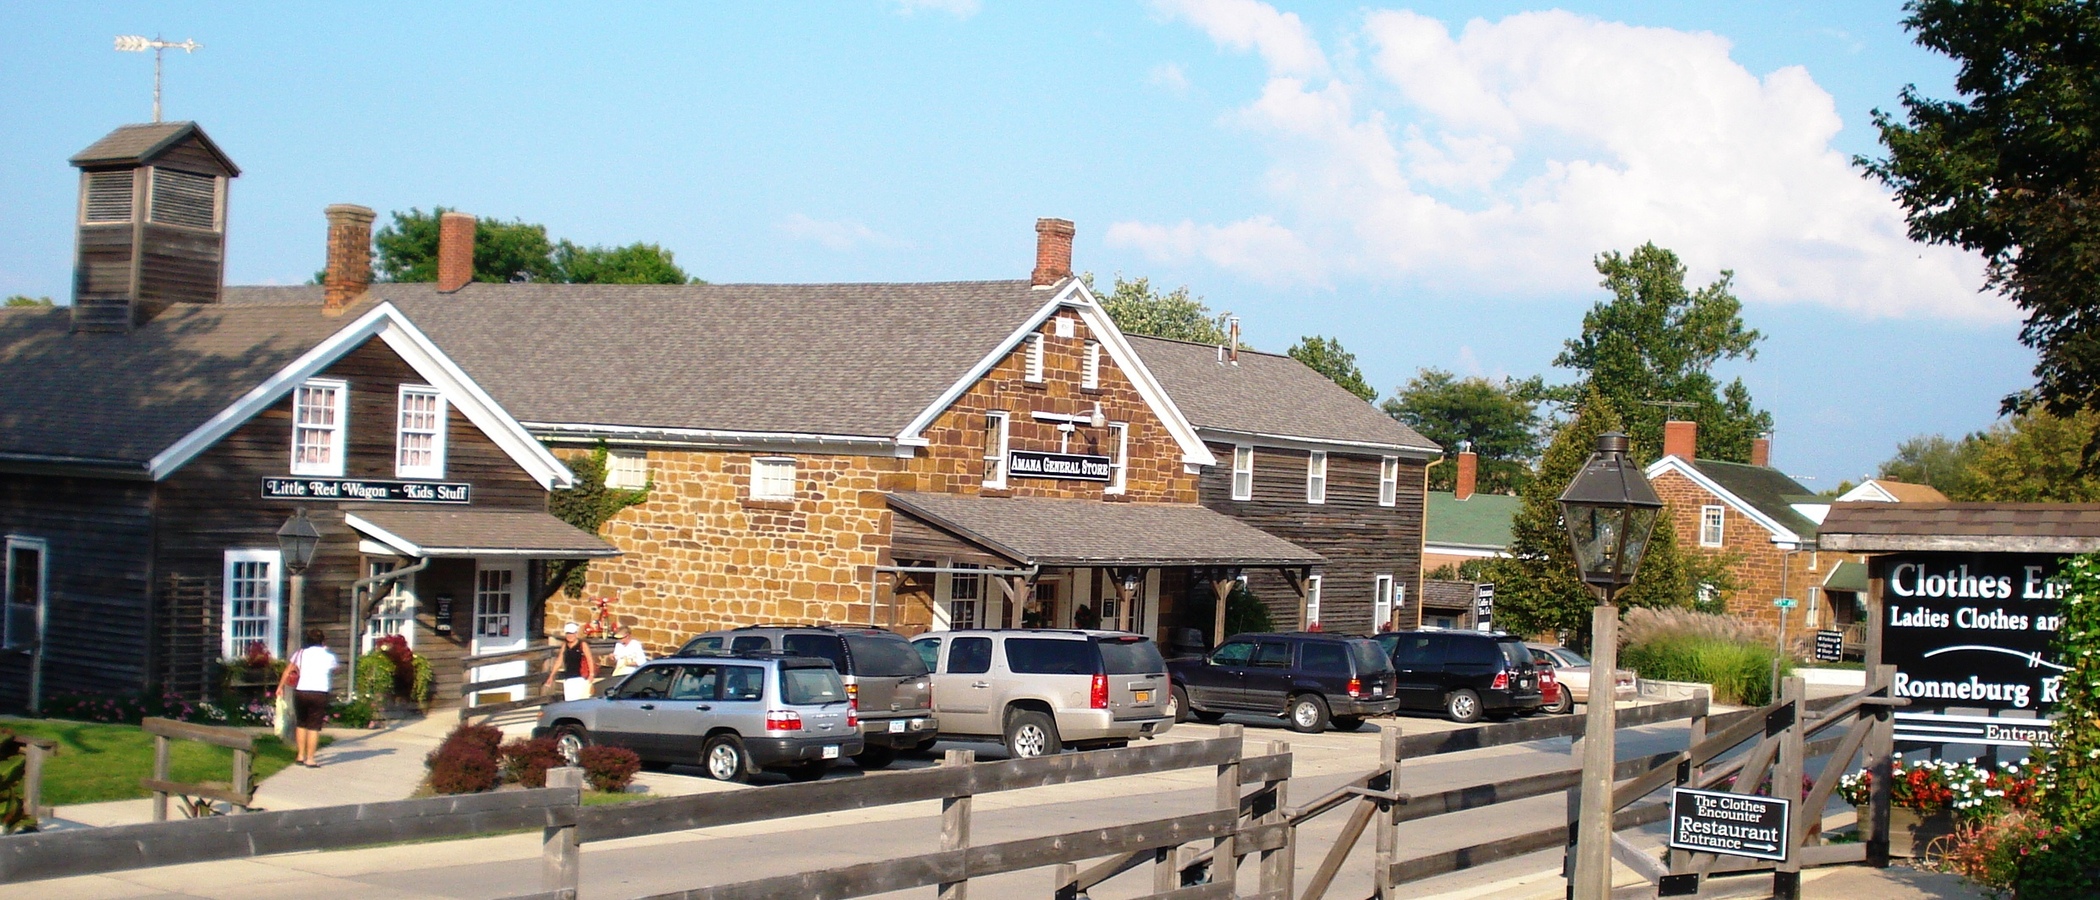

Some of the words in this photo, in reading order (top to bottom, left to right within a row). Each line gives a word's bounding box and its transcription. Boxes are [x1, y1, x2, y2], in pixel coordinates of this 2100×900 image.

[1011, 455, 1042, 472] AMANA
[1043, 457, 1081, 474] GENERAL
[1081, 459, 1108, 476] STORE
[267, 480, 305, 496] Little
[309, 481, 337, 496] Red
[341, 482, 386, 499] Wagon
[403, 484, 433, 499] Kids
[437, 485, 466, 500] Stuff
[1891, 562, 2012, 598] Clothes
[2022, 565, 2071, 599] En
[1890, 606, 1949, 628] Ladies
[1956, 607, 2029, 631] Clothes
[2036, 615, 2066, 631] an
[1894, 672, 2031, 708] Ronneburg
[2041, 677, 2062, 702] R
[1694, 795, 1717, 808] The
[1720, 798, 1766, 814] Clothes
[1697, 806, 1762, 823] Encounter
[1679, 816, 1779, 842] Restaurant
[1679, 831, 1742, 849] Entrance
